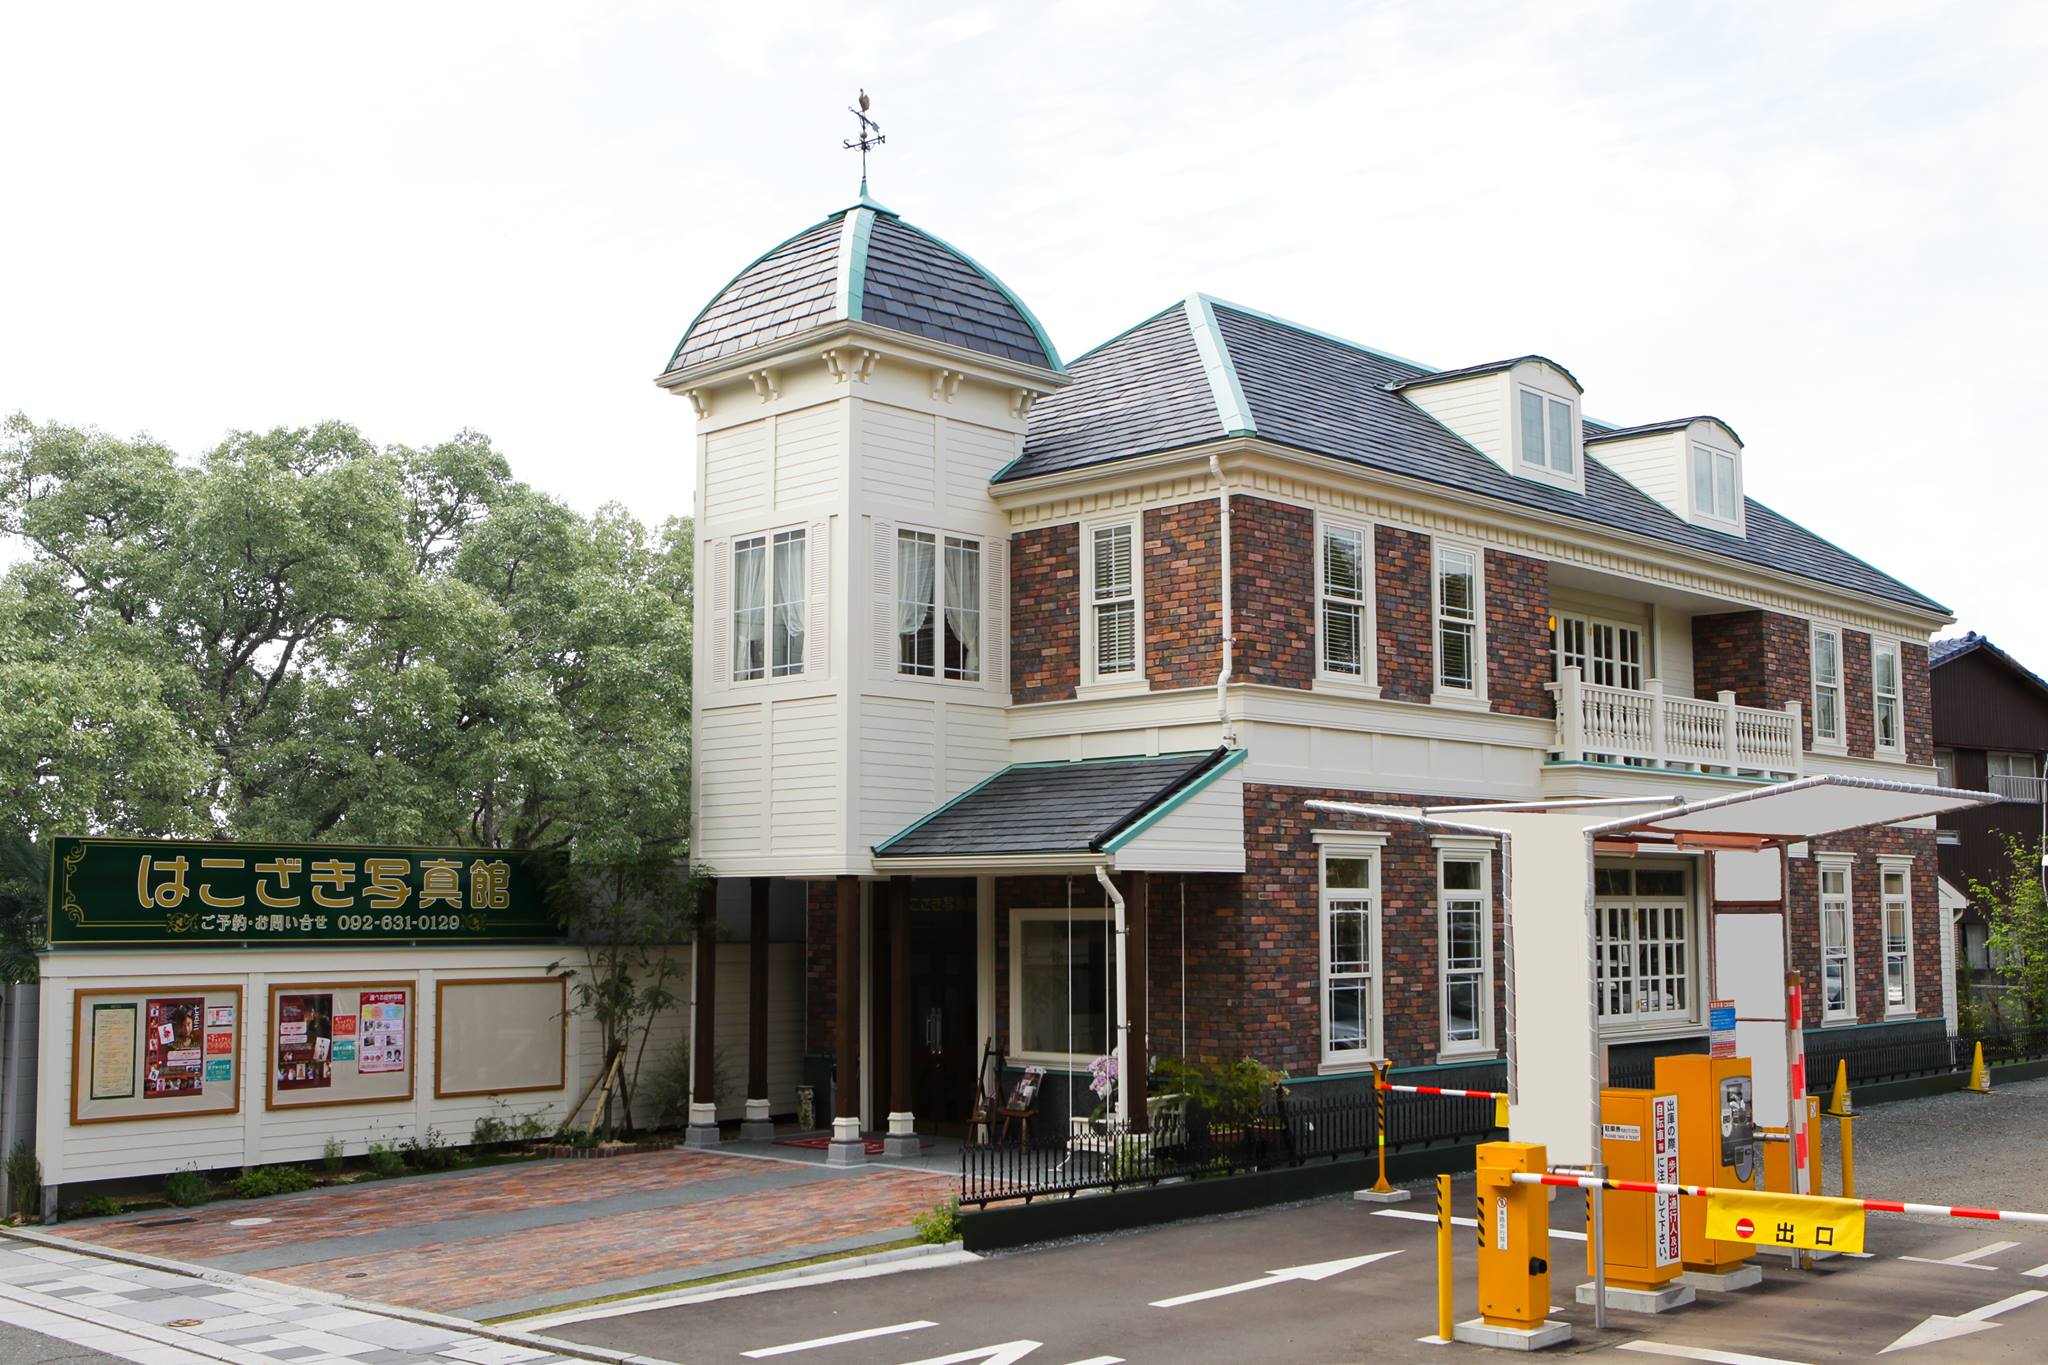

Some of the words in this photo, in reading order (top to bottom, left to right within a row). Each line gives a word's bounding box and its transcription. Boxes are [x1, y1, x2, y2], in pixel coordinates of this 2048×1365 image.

[138, 855, 511, 909] はこざき写真館
[337, 915, 460, 931] 092-631-0129
[1776, 1222, 1833, 1246] 出口
